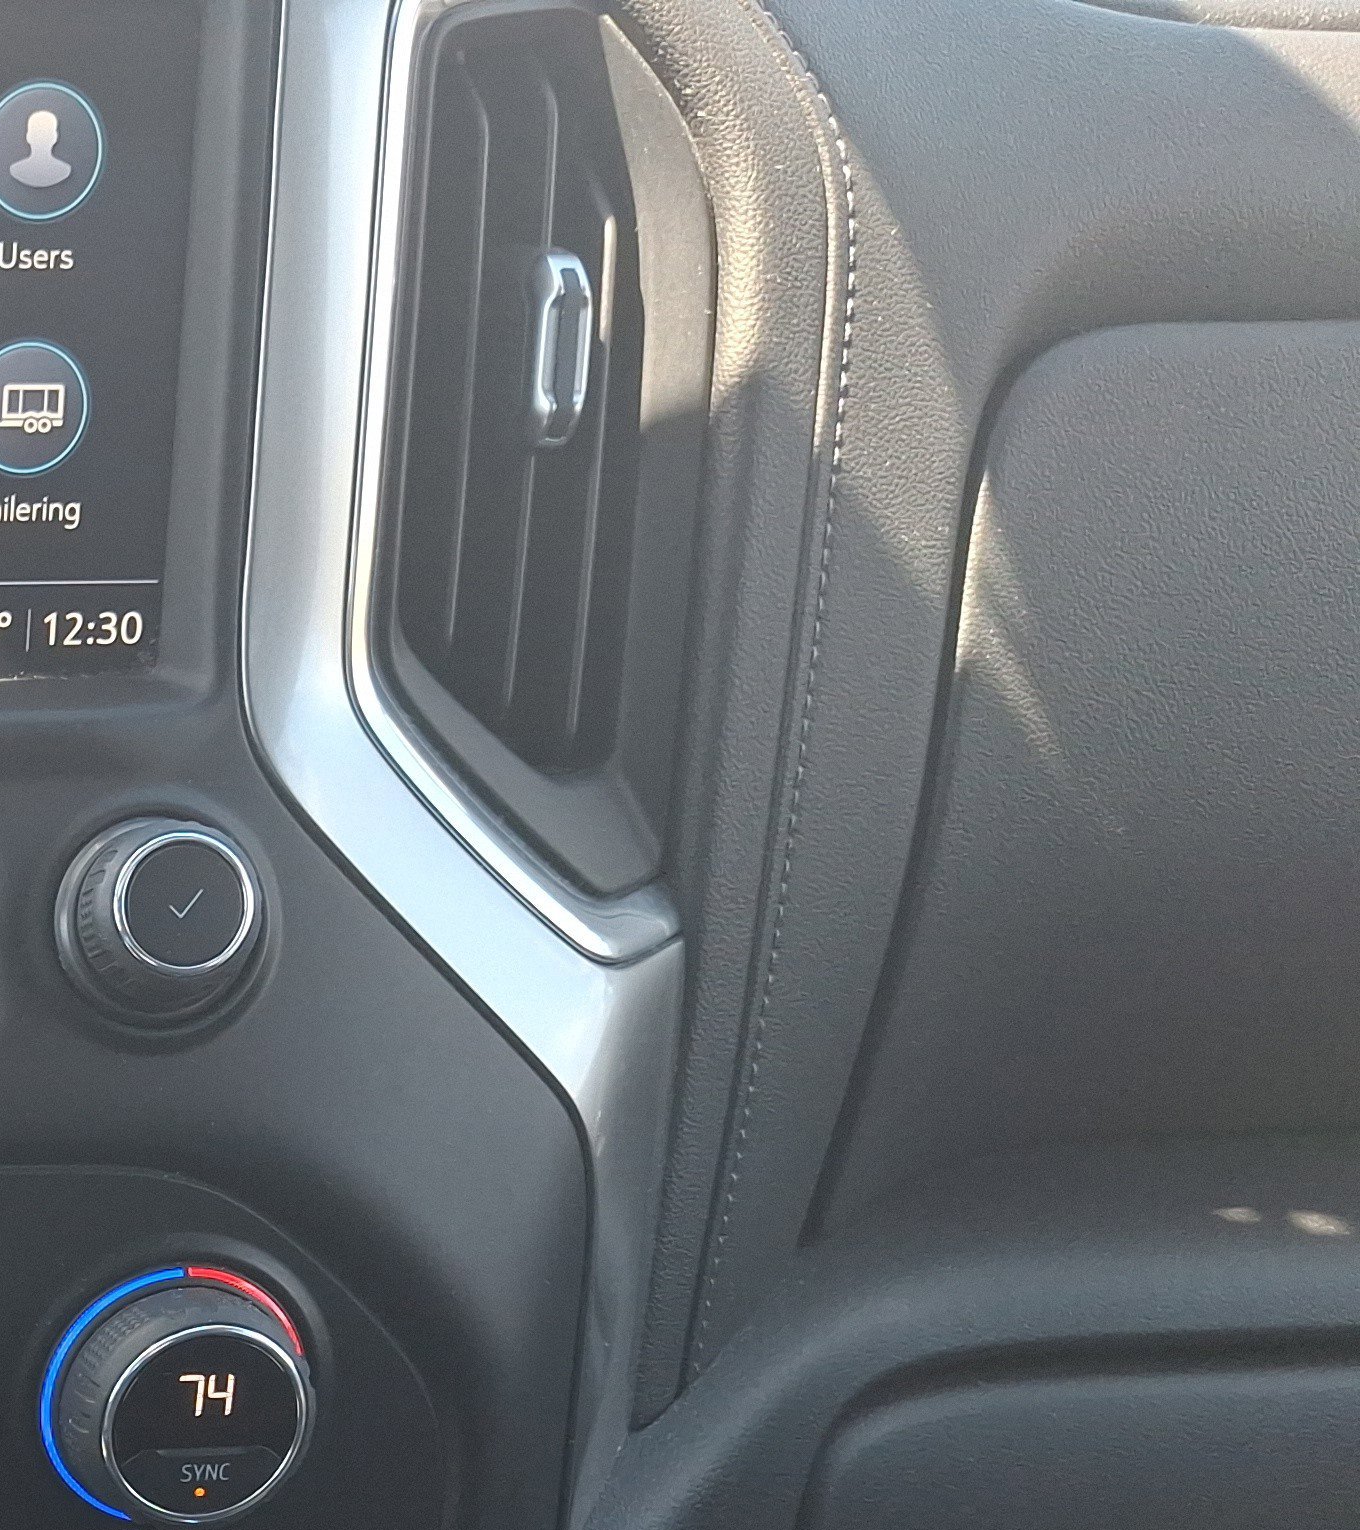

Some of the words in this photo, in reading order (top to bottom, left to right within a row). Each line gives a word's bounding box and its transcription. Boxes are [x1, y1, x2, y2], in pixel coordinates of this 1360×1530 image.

[43, 611, 143, 646] 12:30
[179, 1373, 235, 1417] 74
[180, 1462, 230, 1483] SYNC
